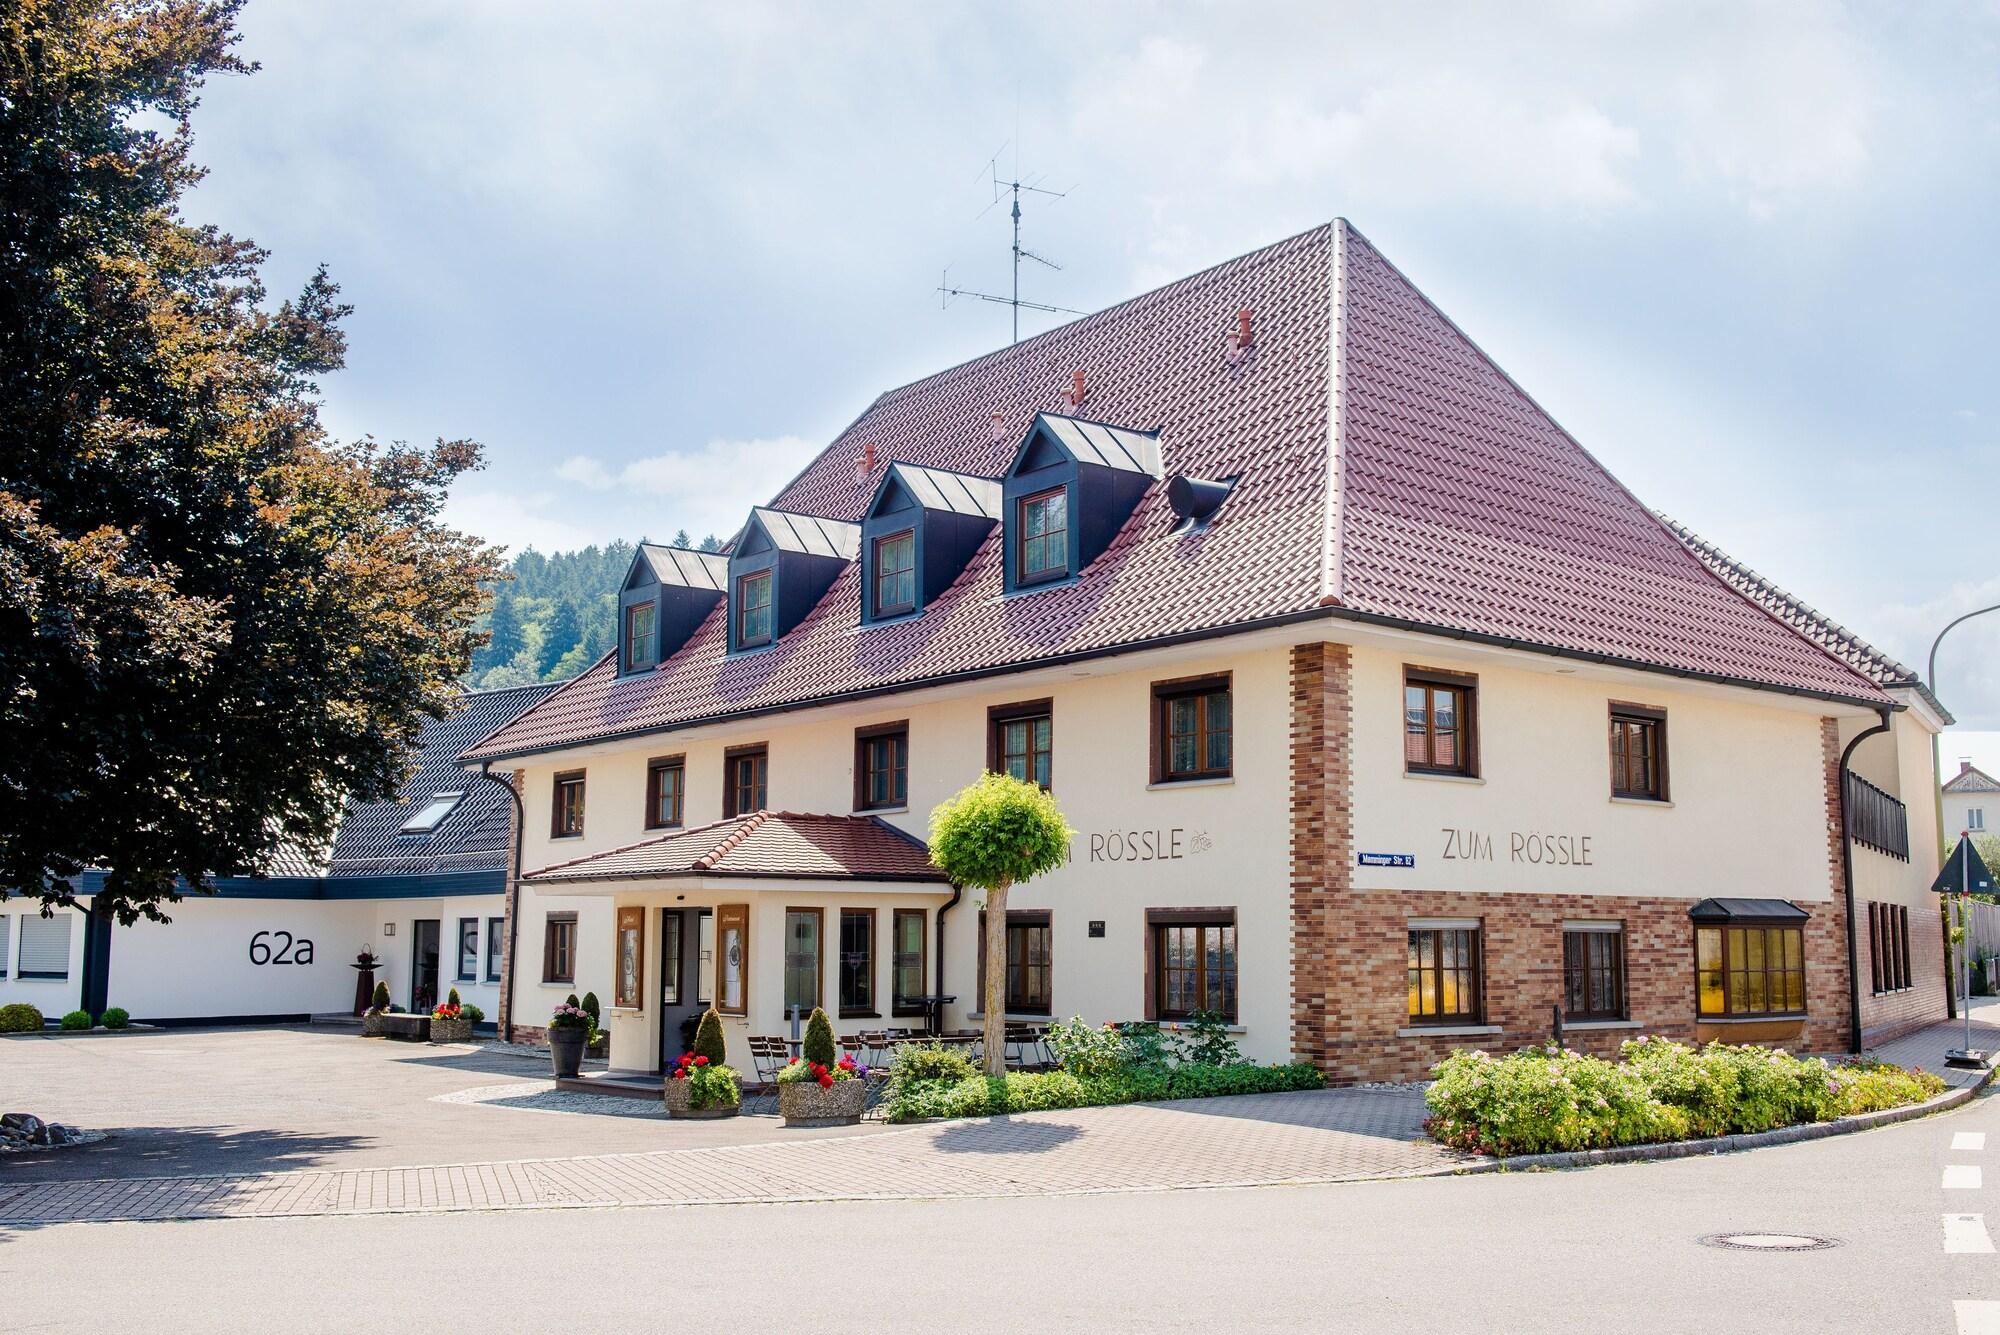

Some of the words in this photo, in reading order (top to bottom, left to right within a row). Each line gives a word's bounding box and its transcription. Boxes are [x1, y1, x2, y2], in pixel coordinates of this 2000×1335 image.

[1090, 828, 1184, 863] RÖSSLE
[1442, 828, 1493, 862] ZUM
[1511, 830, 1593, 866] RÖSSLE
[249, 930, 314, 966] 62a
